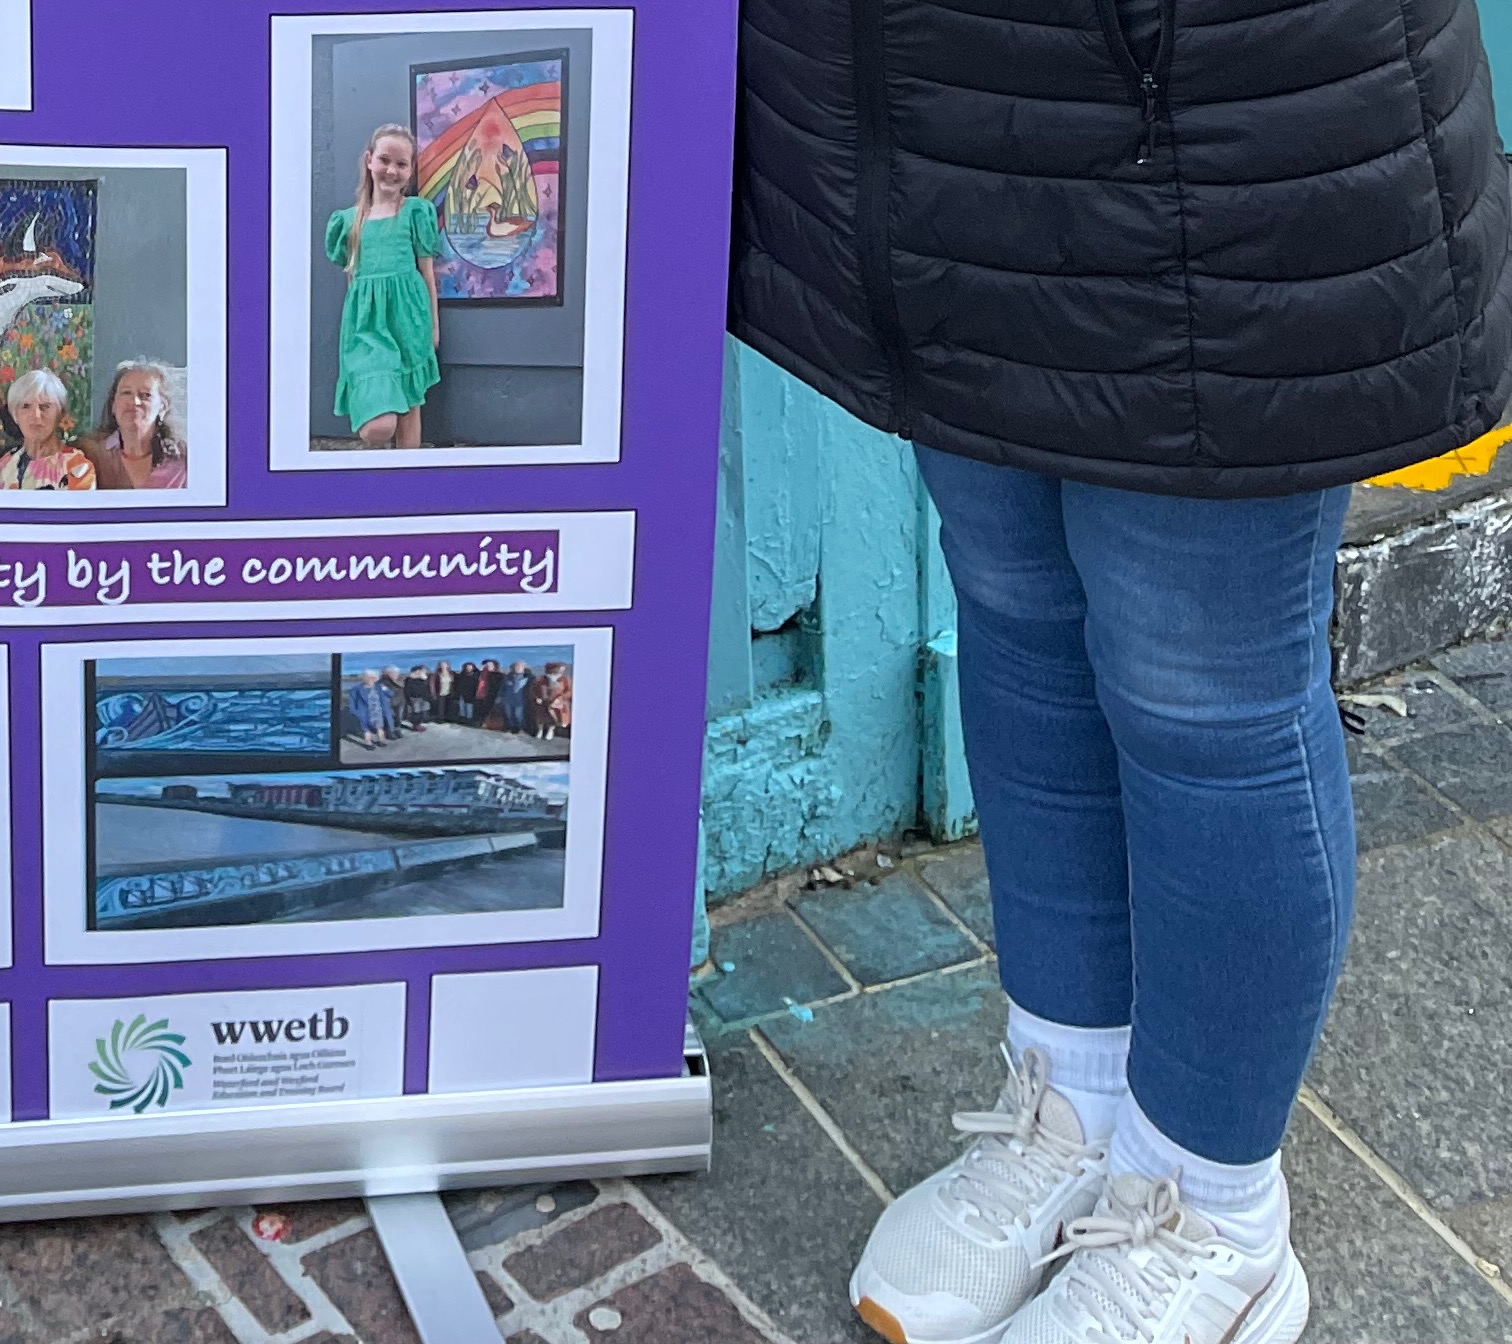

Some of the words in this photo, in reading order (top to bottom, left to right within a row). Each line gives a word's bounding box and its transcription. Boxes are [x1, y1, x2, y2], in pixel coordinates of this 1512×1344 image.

[66, 548, 131, 605] by
[146, 549, 227, 587] the
[240, 536, 556, 595] community
[210, 1007, 350, 1045] wwetb
